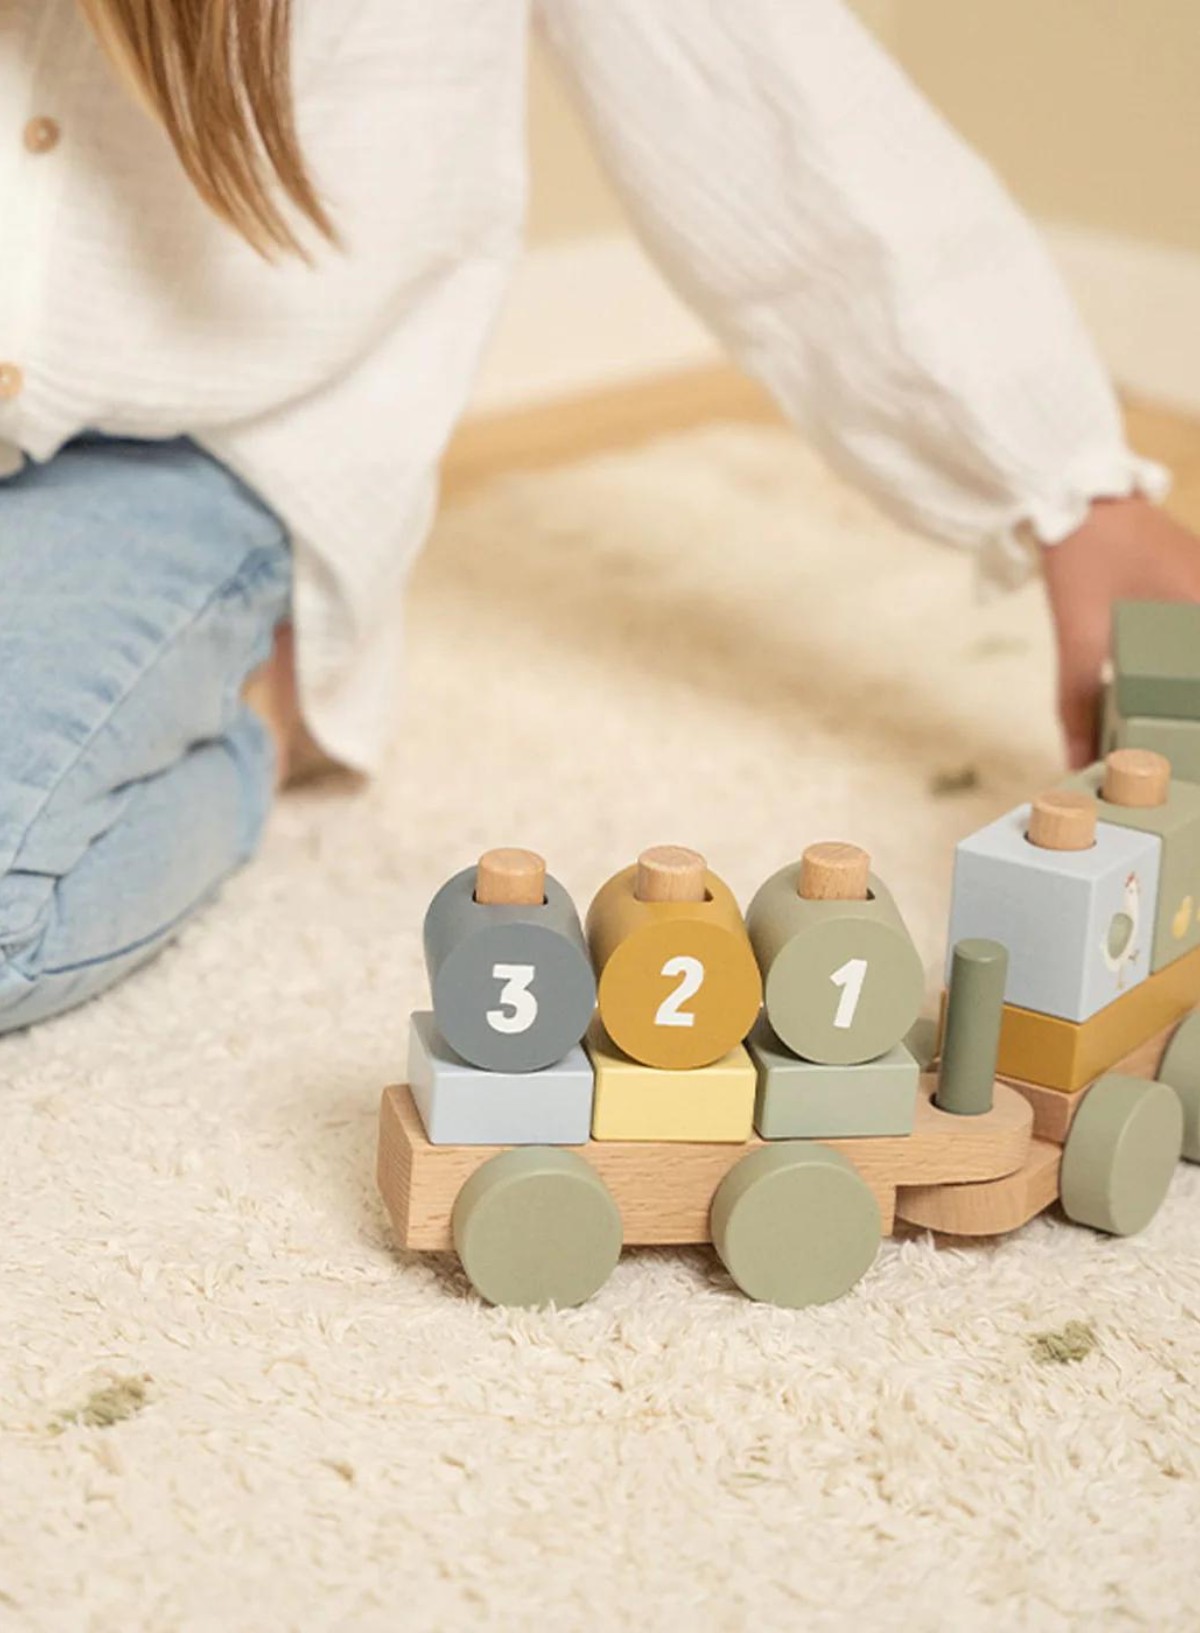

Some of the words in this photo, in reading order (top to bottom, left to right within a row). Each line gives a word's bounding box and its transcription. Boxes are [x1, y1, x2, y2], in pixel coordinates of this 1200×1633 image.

[485, 963, 539, 1035] 3
[654, 956, 705, 1027] 2
[829, 958, 868, 1029] 1
